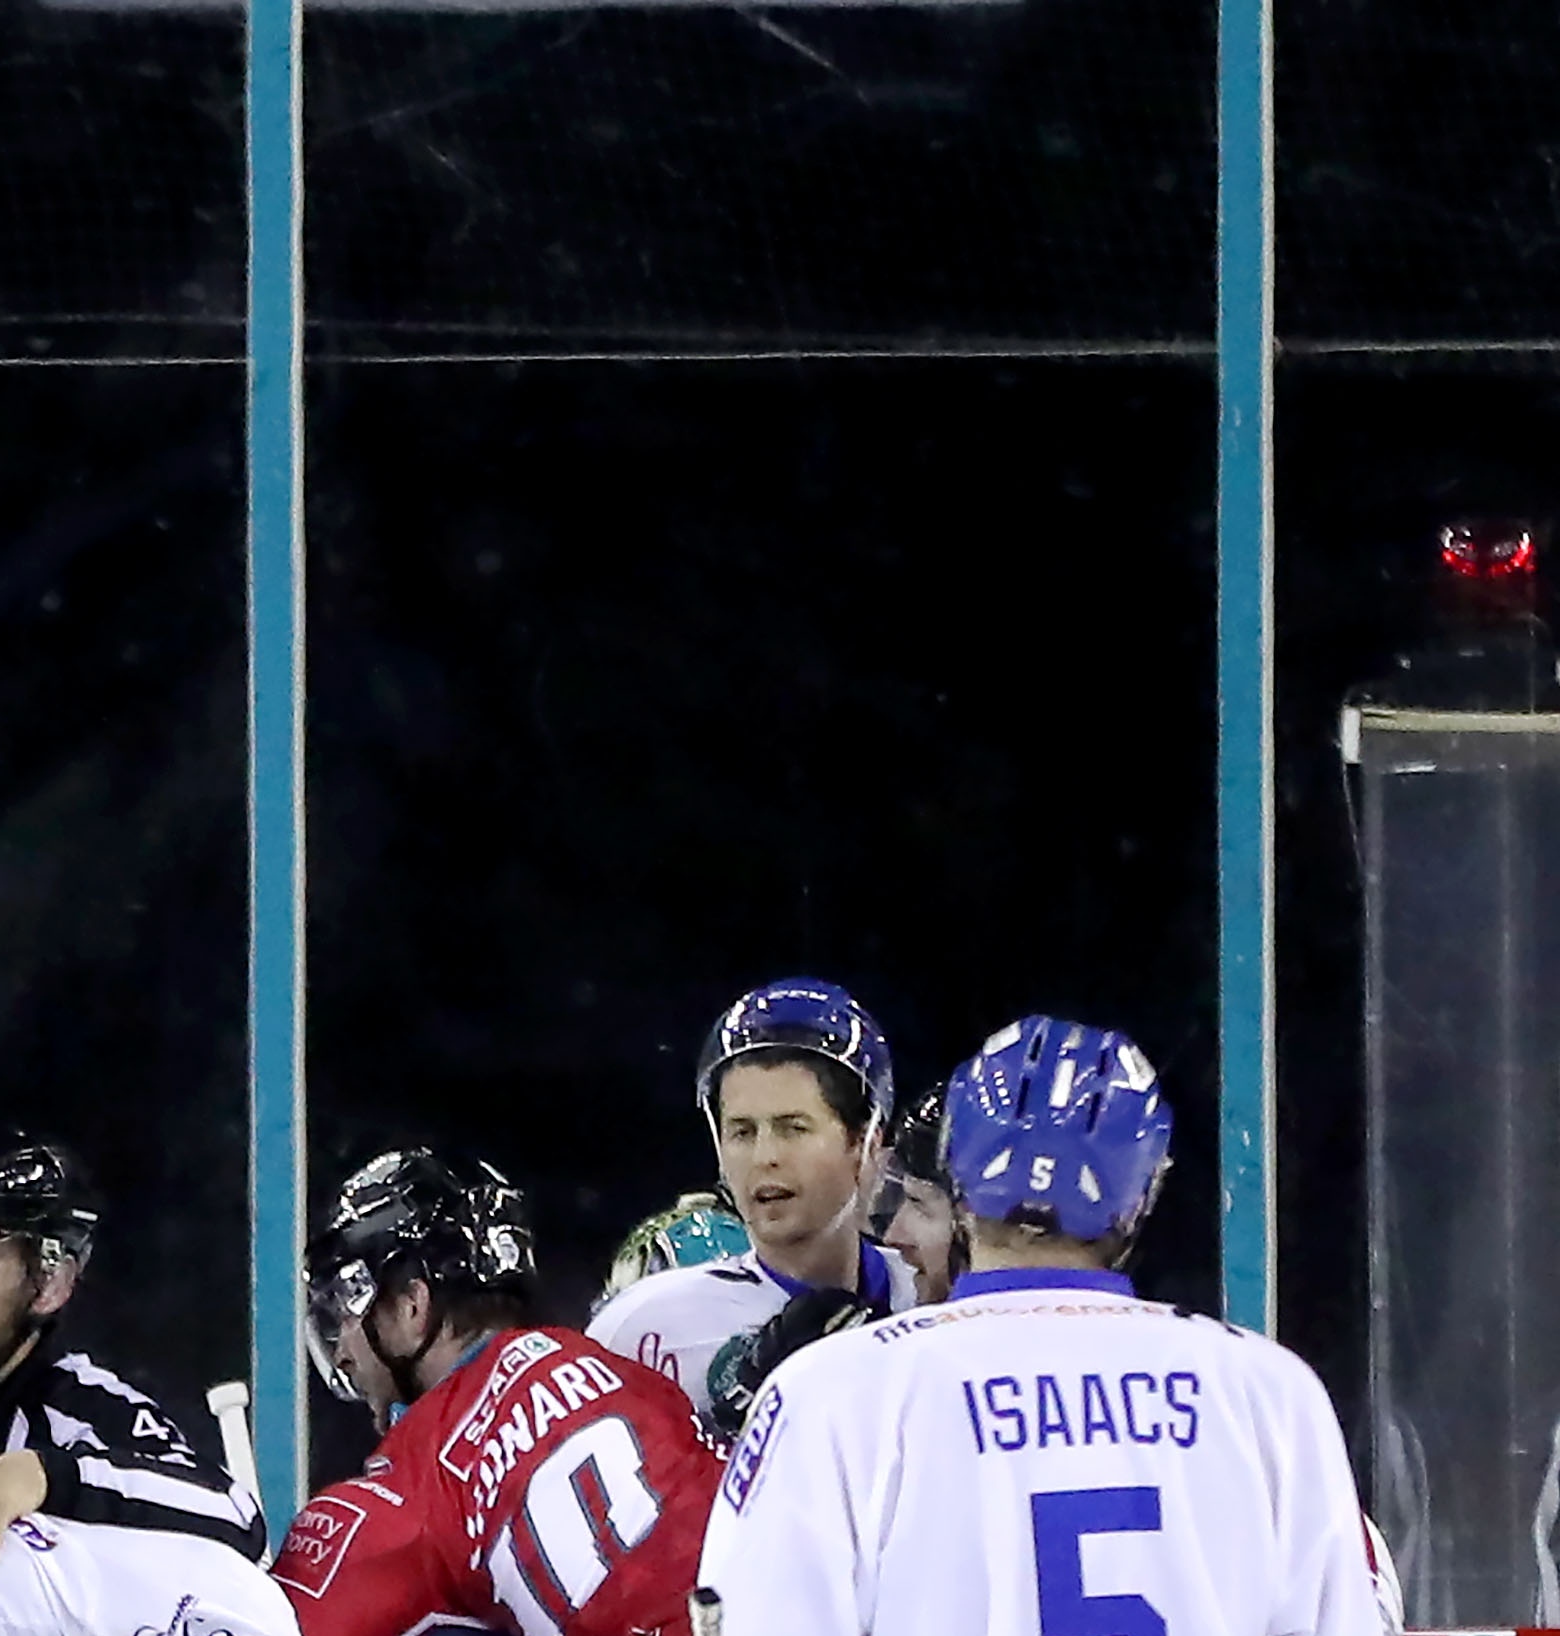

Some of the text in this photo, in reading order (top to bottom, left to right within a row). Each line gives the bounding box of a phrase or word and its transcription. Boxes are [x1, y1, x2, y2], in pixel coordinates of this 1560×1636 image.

[1029, 1156, 1057, 1191] 5
[963, 1371, 1201, 1454] ISAACS
[296, 1509, 344, 1540] arry
[288, 1532, 334, 1565] orry
